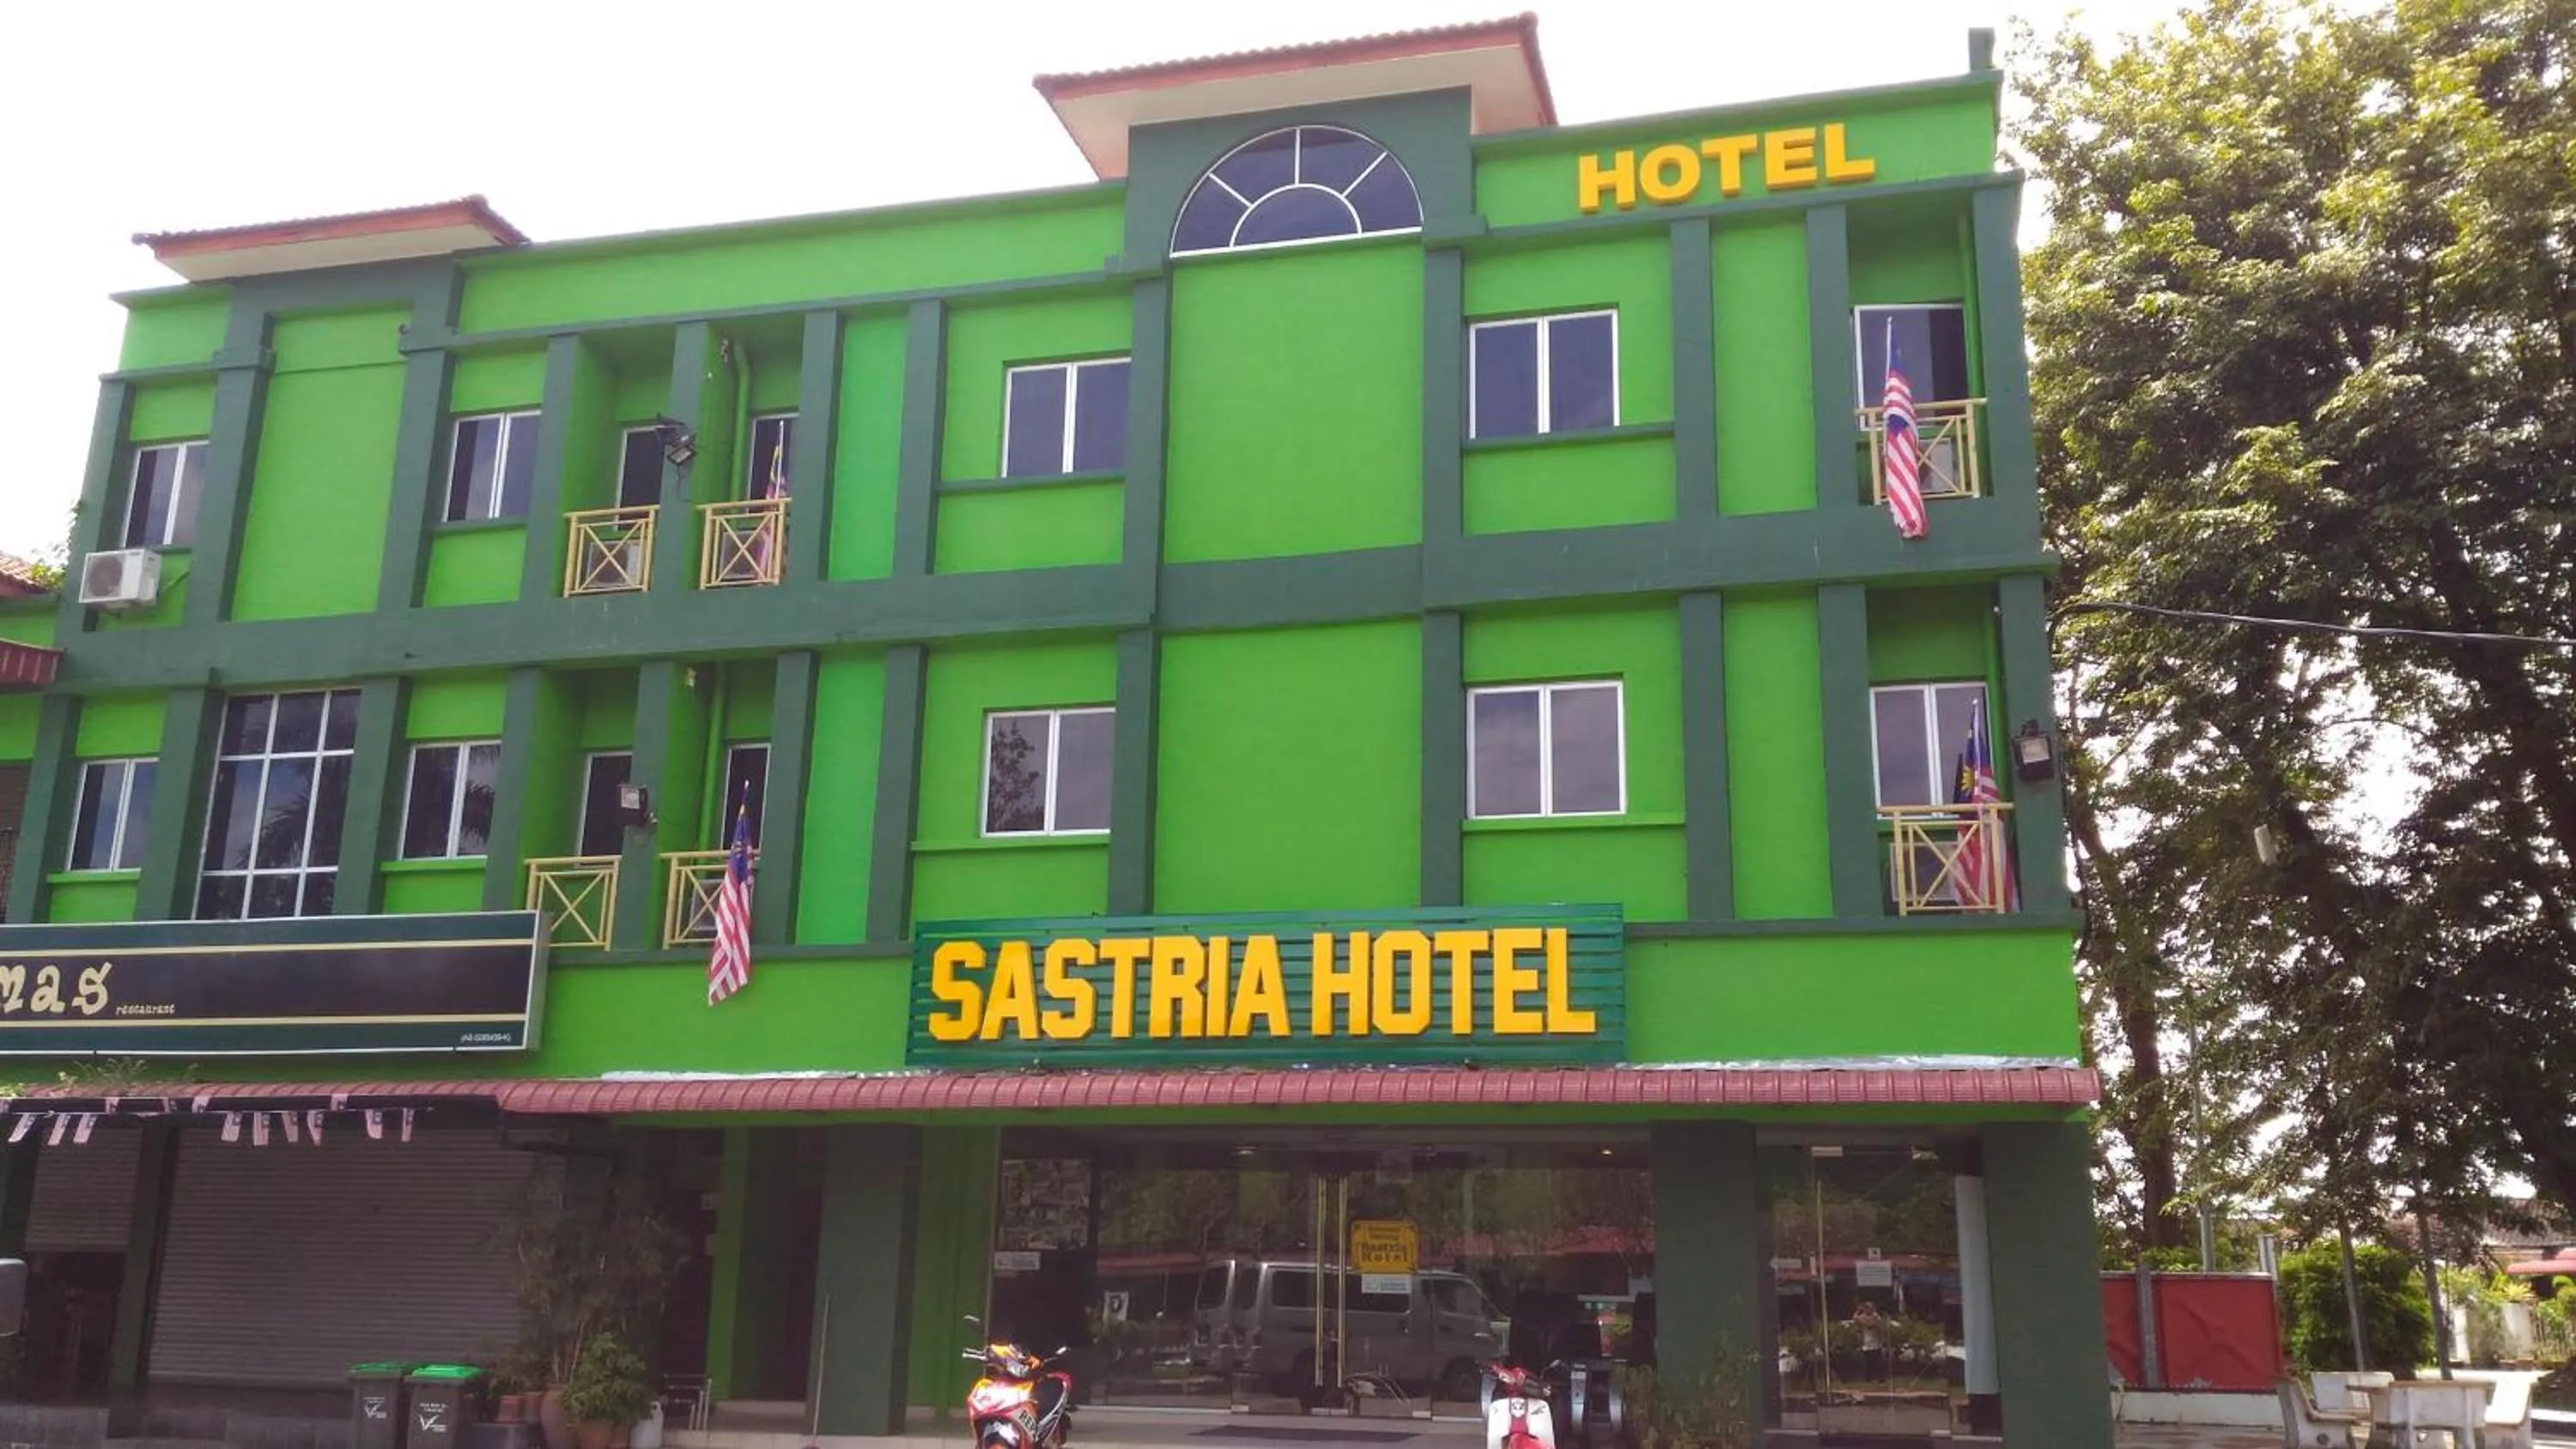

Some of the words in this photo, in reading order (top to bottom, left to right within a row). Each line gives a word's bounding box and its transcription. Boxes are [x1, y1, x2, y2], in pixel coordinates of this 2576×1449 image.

[1578, 123, 1875, 214] HOTEL
[928, 934, 1290, 1041] SASTRIA
[1311, 927, 1596, 1037] HOTEL
